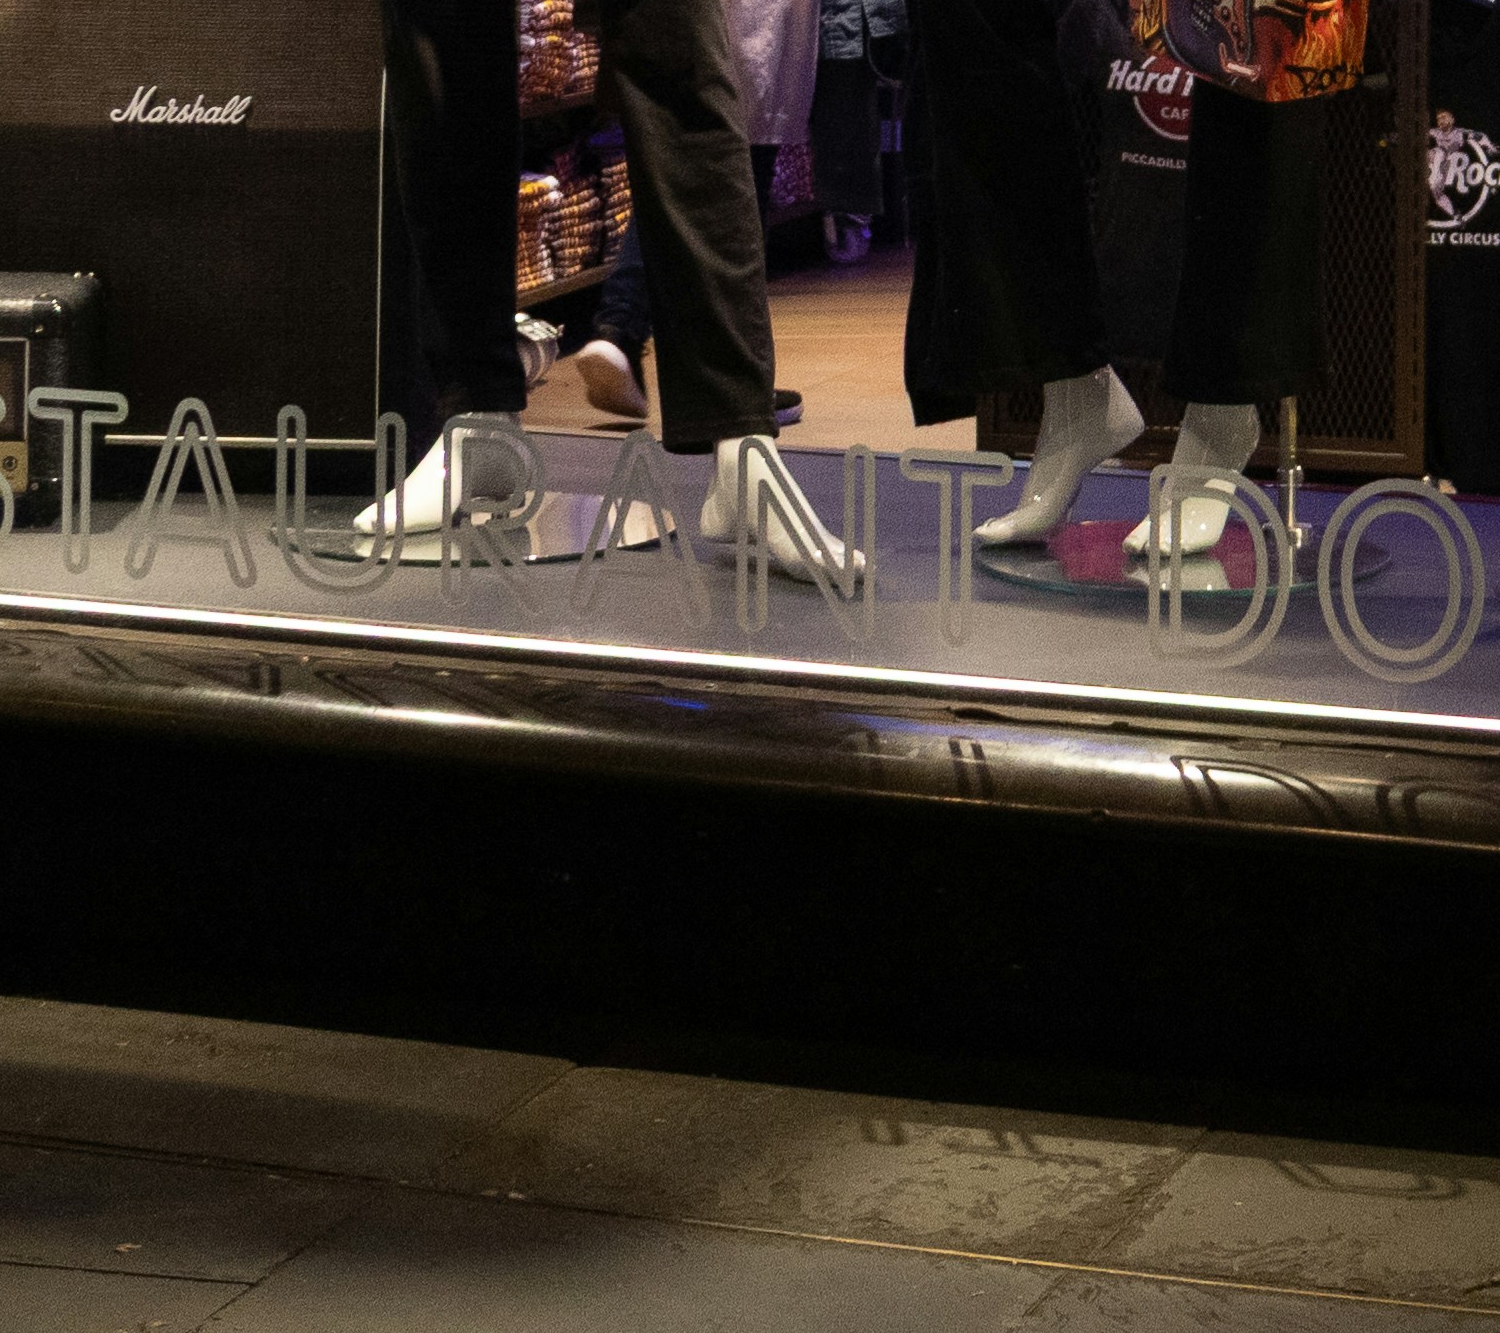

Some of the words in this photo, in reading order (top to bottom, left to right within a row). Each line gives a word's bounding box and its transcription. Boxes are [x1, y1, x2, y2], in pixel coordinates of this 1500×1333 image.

[1106, 59, 1181, 94] Hard
[110, 85, 252, 125] Marshall
[1160, 106, 1190, 120] CAF
[1449, 232, 1500, 246] CIRCUS
